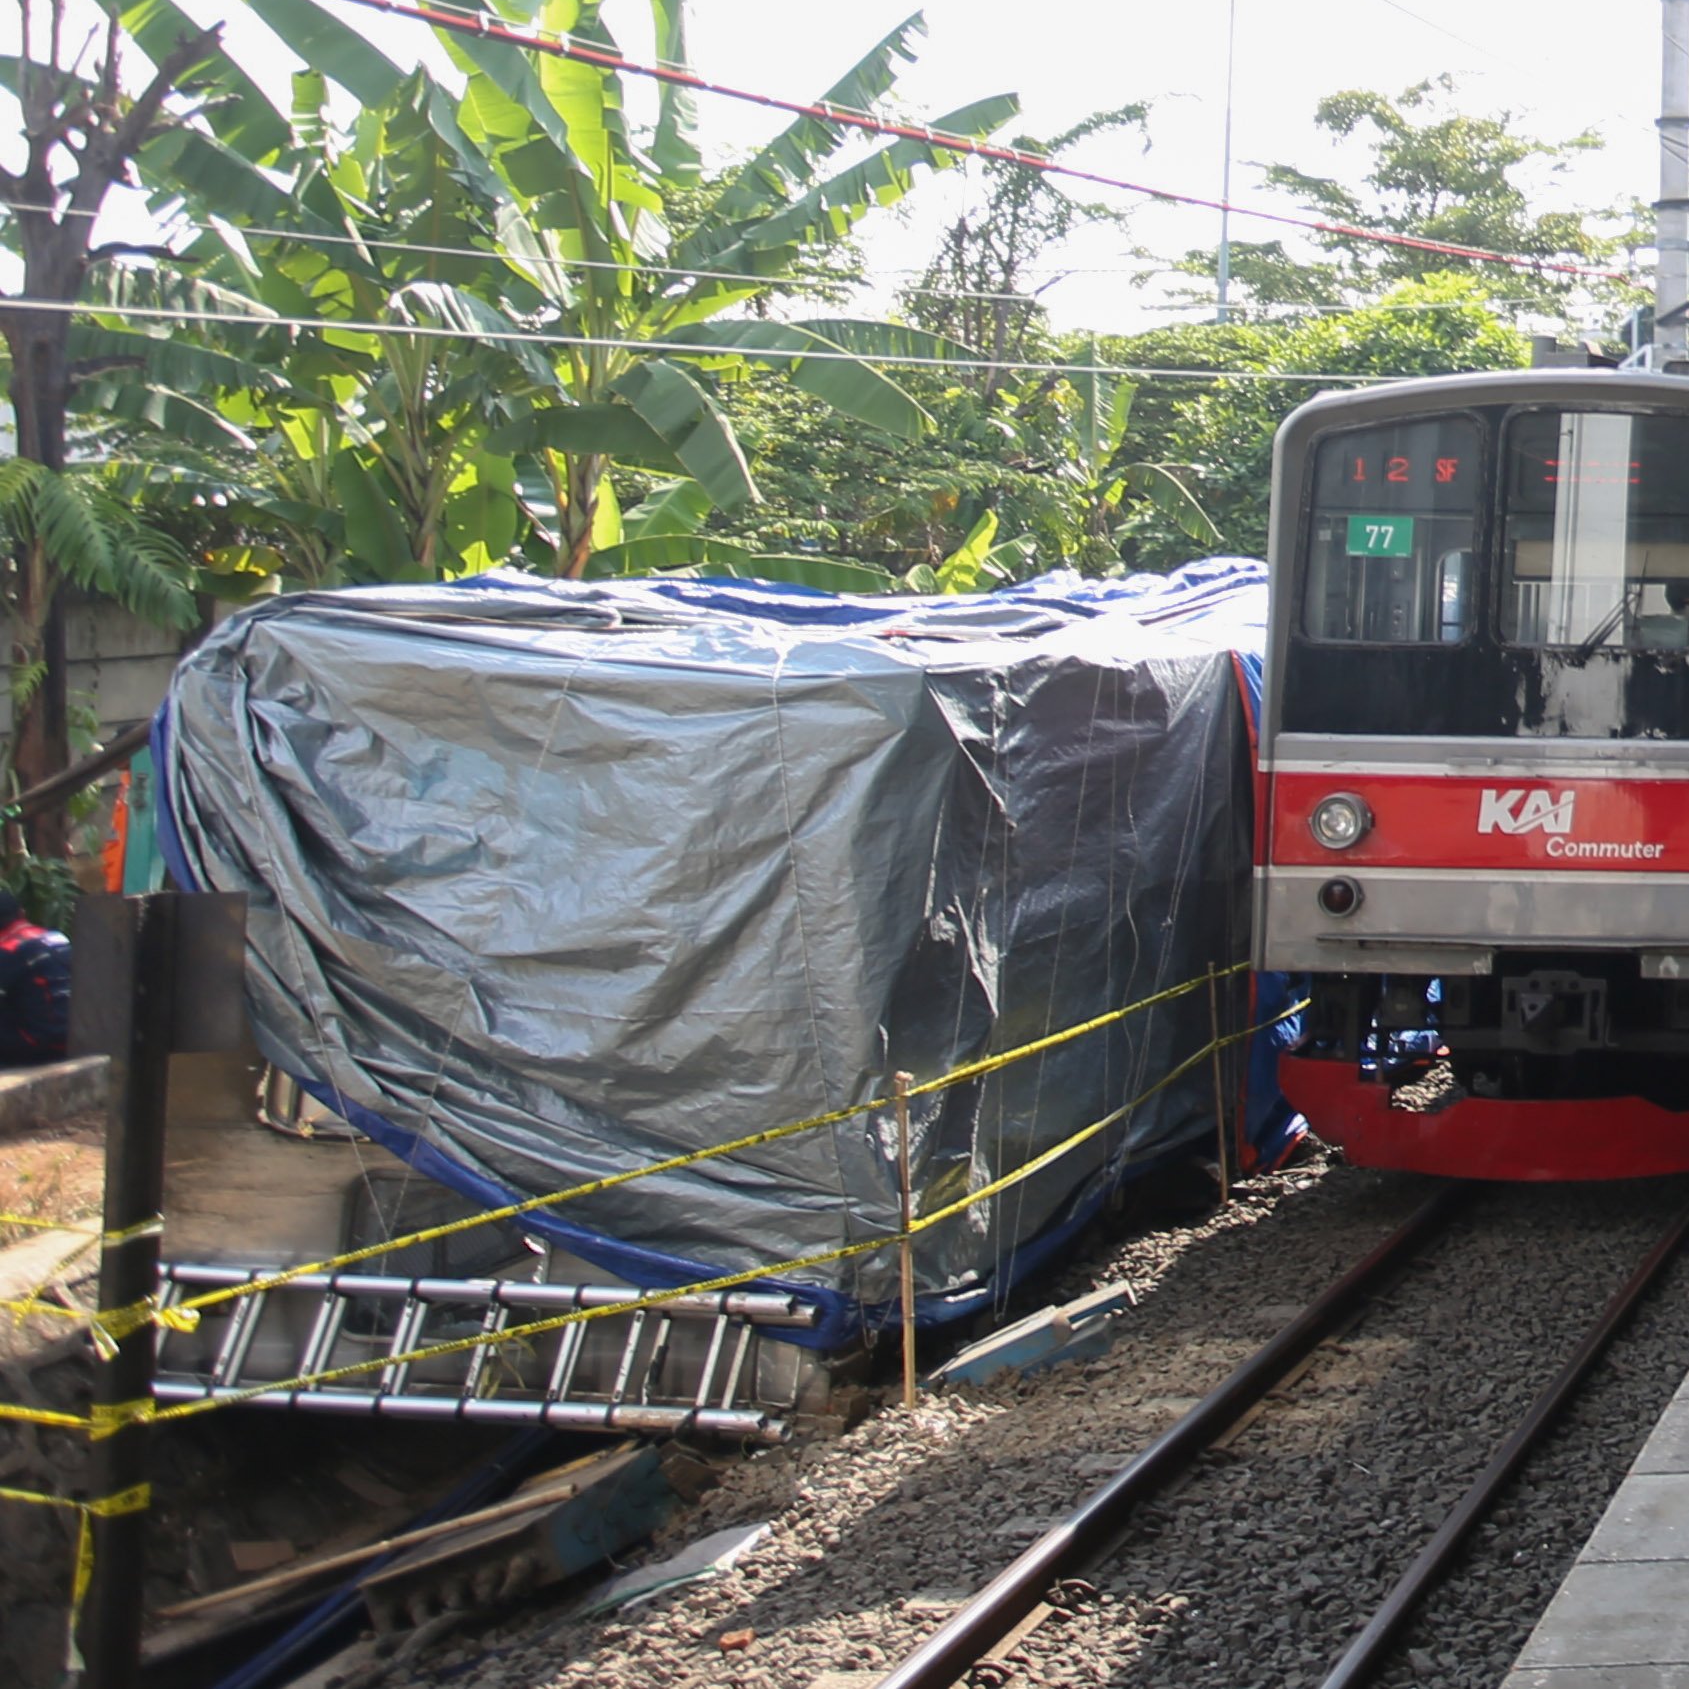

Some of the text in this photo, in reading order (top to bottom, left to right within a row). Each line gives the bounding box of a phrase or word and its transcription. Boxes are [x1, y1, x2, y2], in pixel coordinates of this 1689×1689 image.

[1365, 524, 1394, 549] 77
[1478, 789, 1575, 834] KAI
[1546, 836, 1664, 859] Commuter
